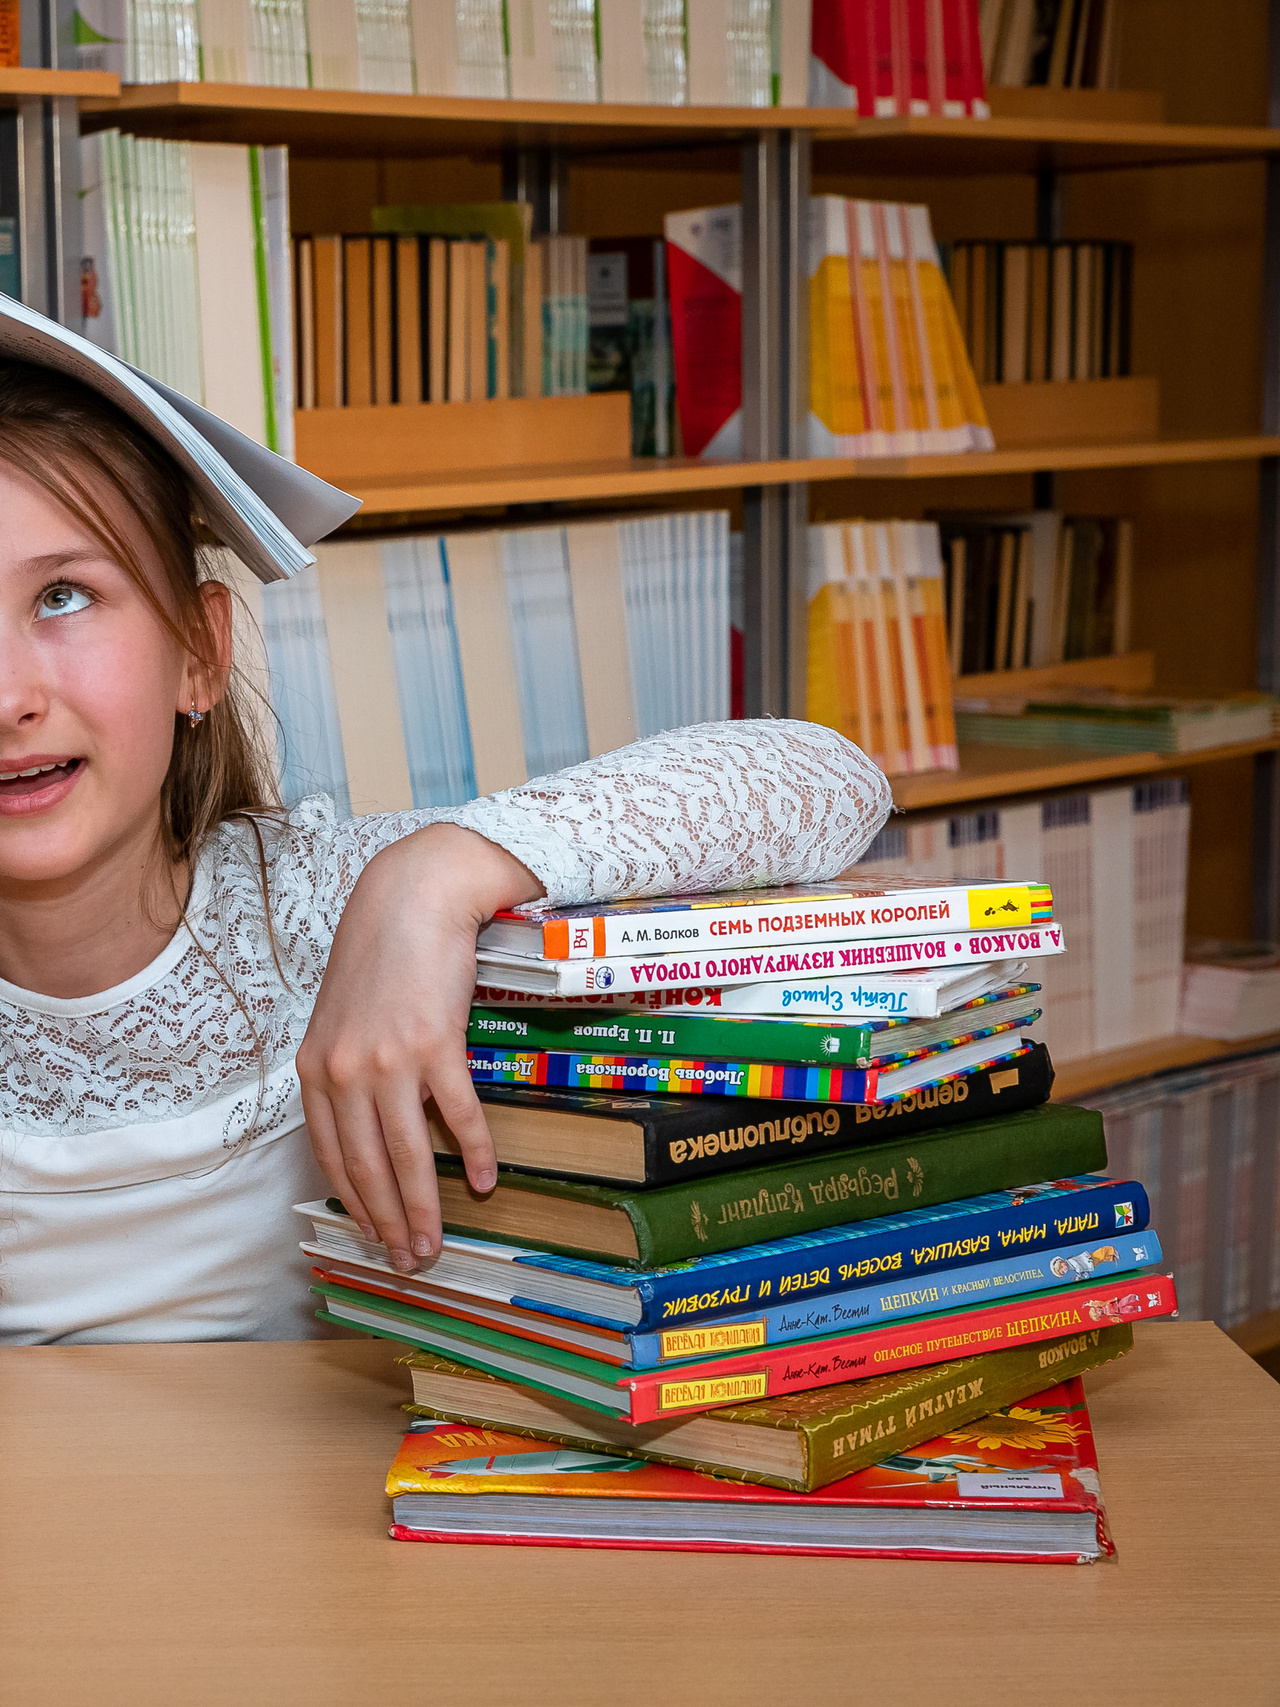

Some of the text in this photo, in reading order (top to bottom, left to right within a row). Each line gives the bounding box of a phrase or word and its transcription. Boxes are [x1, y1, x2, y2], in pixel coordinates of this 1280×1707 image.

[621, 900, 950, 942] А. М. Волков СЕМЬ ПОДЗЕМНЫХ КОРОЛЕЙ
[574, 928, 589, 950] ВЧ
[630, 930, 1061, 984] А. ВОЛКОВ ВОЛШЕБНИК ИЗУМРУДНОГО ГОРОДА
[782, 984, 844, 1011] Ершов
[851, 986, 909, 1014] Пётр
[478, 1019, 528, 1036] Конёк
[574, 1026, 629, 1042] Ершов
[635, 1029, 652, 1043] П.
[658, 1030, 676, 1044] П.
[576, 1063, 670, 1082] Воронкова
[675, 1069, 745, 1085] Любовь
[670, 1076, 969, 1164] детская библиотека
[717, 1183, 804, 1224] Киплинг
[998, 1223, 1047, 1247] МАМА,
[1054, 1212, 1100, 1235] ПАПА,
[911, 1235, 990, 1265] БАБУШКА,
[838, 1252, 903, 1281] ВОСЕМЬ
[663, 1284, 750, 1318] ГРУЗОВИК
[758, 1280, 771, 1297] И
[881, 1288, 939, 1311] ЩЕПКИН
[942, 1286, 949, 1296] И
[951, 1277, 991, 1295] КРАСНЫЙ
[993, 1268, 1044, 1287] ВЕЛОСИПЕД
[873, 1342, 924, 1362] ОПАСНОЕ
[926, 1326, 1003, 1352] ПУТЕШЕСТВИЕ
[1006, 1310, 1082, 1338] ЩЕПКИНА
[833, 1378, 984, 1458] ЖЕЛТЫЙ ТУМАН
